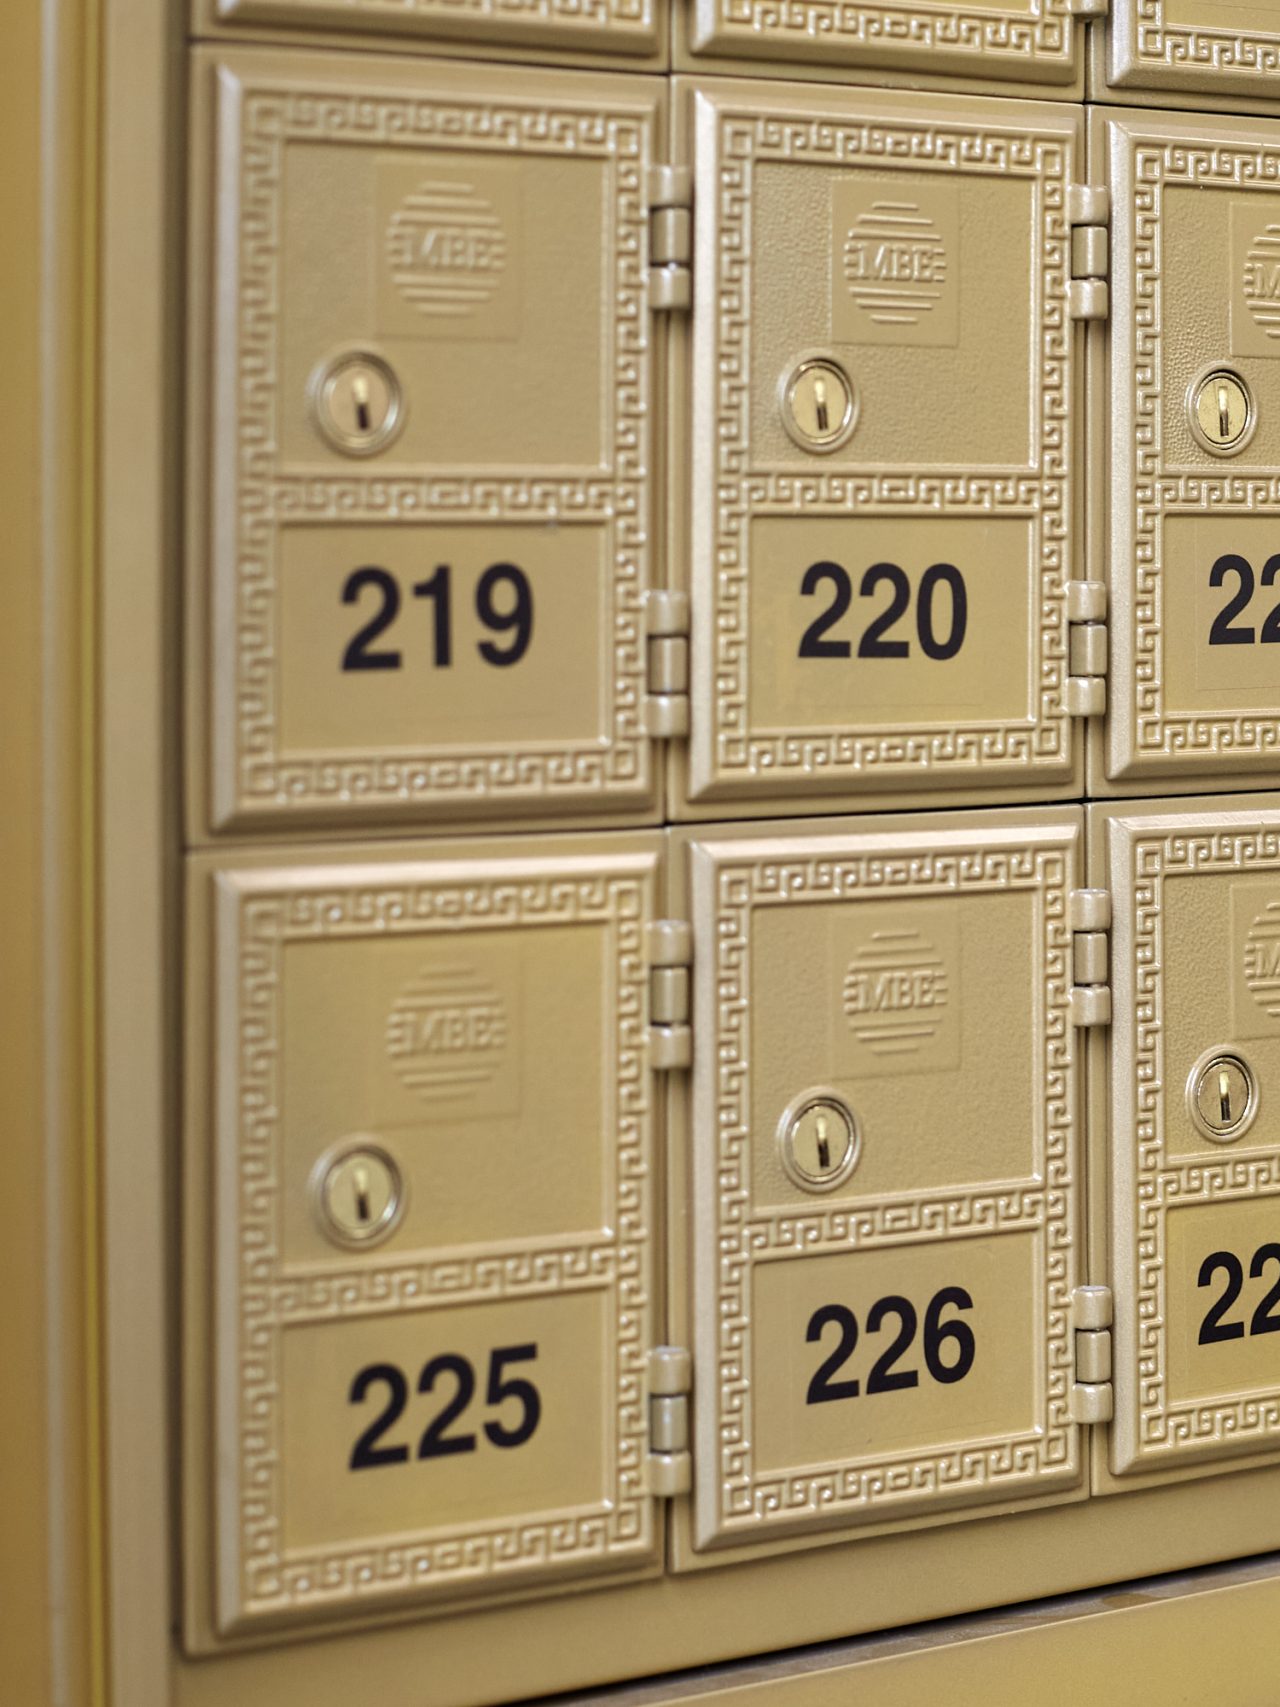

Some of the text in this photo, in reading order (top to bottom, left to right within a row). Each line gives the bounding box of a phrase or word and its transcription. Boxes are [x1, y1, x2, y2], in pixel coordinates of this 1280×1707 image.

[342, 562, 534, 673] 219
[799, 561, 968, 661] 220
[806, 1286, 976, 1406] 226
[349, 1342, 542, 1472] 225
